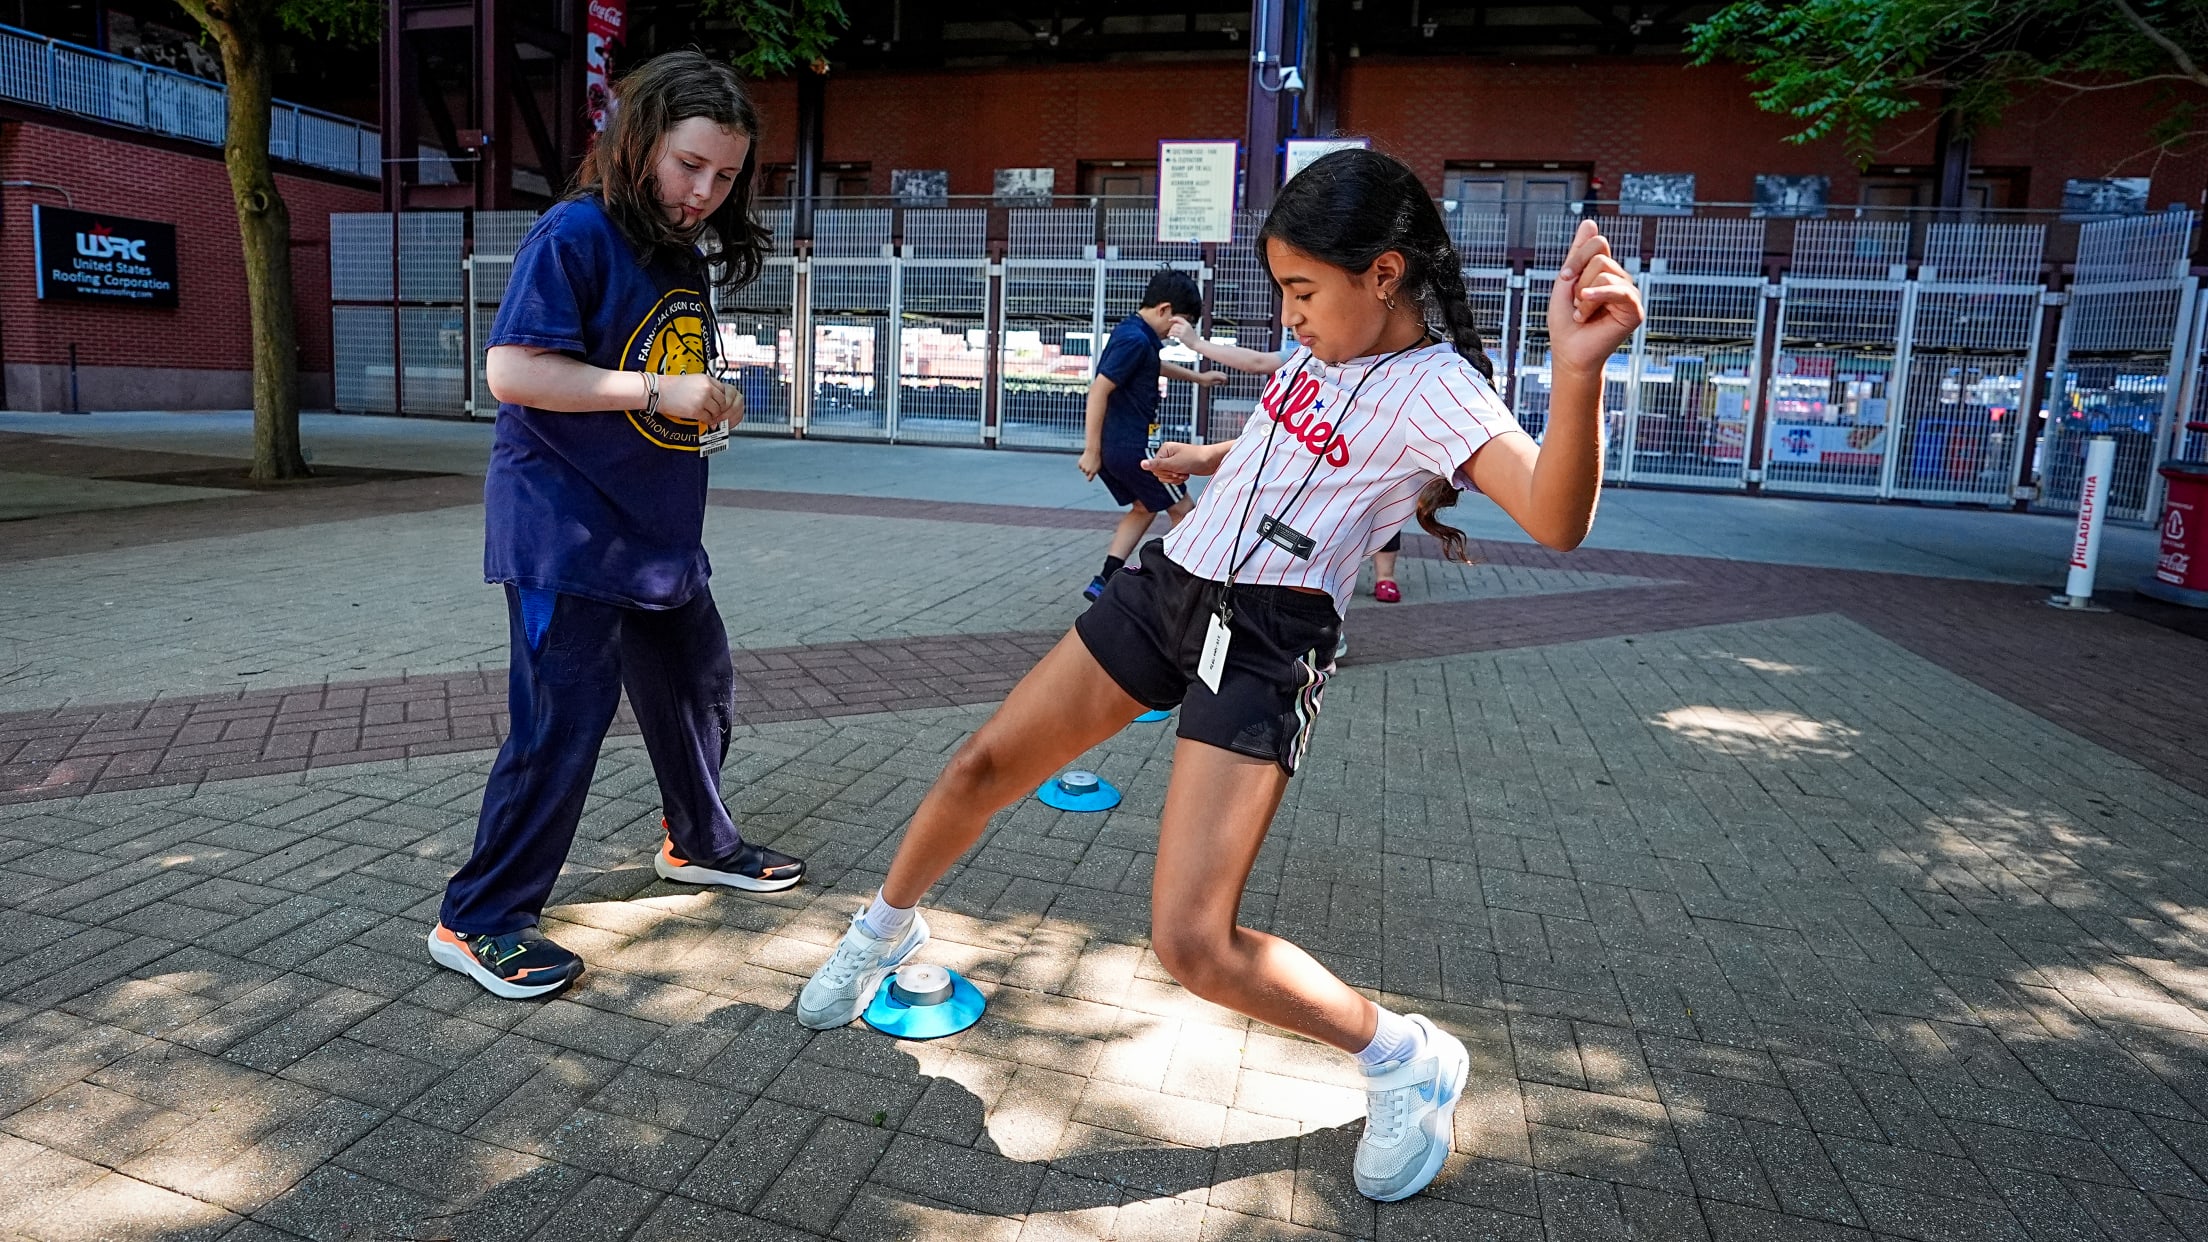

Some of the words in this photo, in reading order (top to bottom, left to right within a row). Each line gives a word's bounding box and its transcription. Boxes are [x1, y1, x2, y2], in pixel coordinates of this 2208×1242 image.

[76, 232, 146, 261] USRC
[73, 257, 113, 273] United
[116, 261, 152, 276] States
[52, 268, 101, 287] Roofing
[104, 274, 170, 291] Corporation
[670, 432, 698, 442] EQUIT
